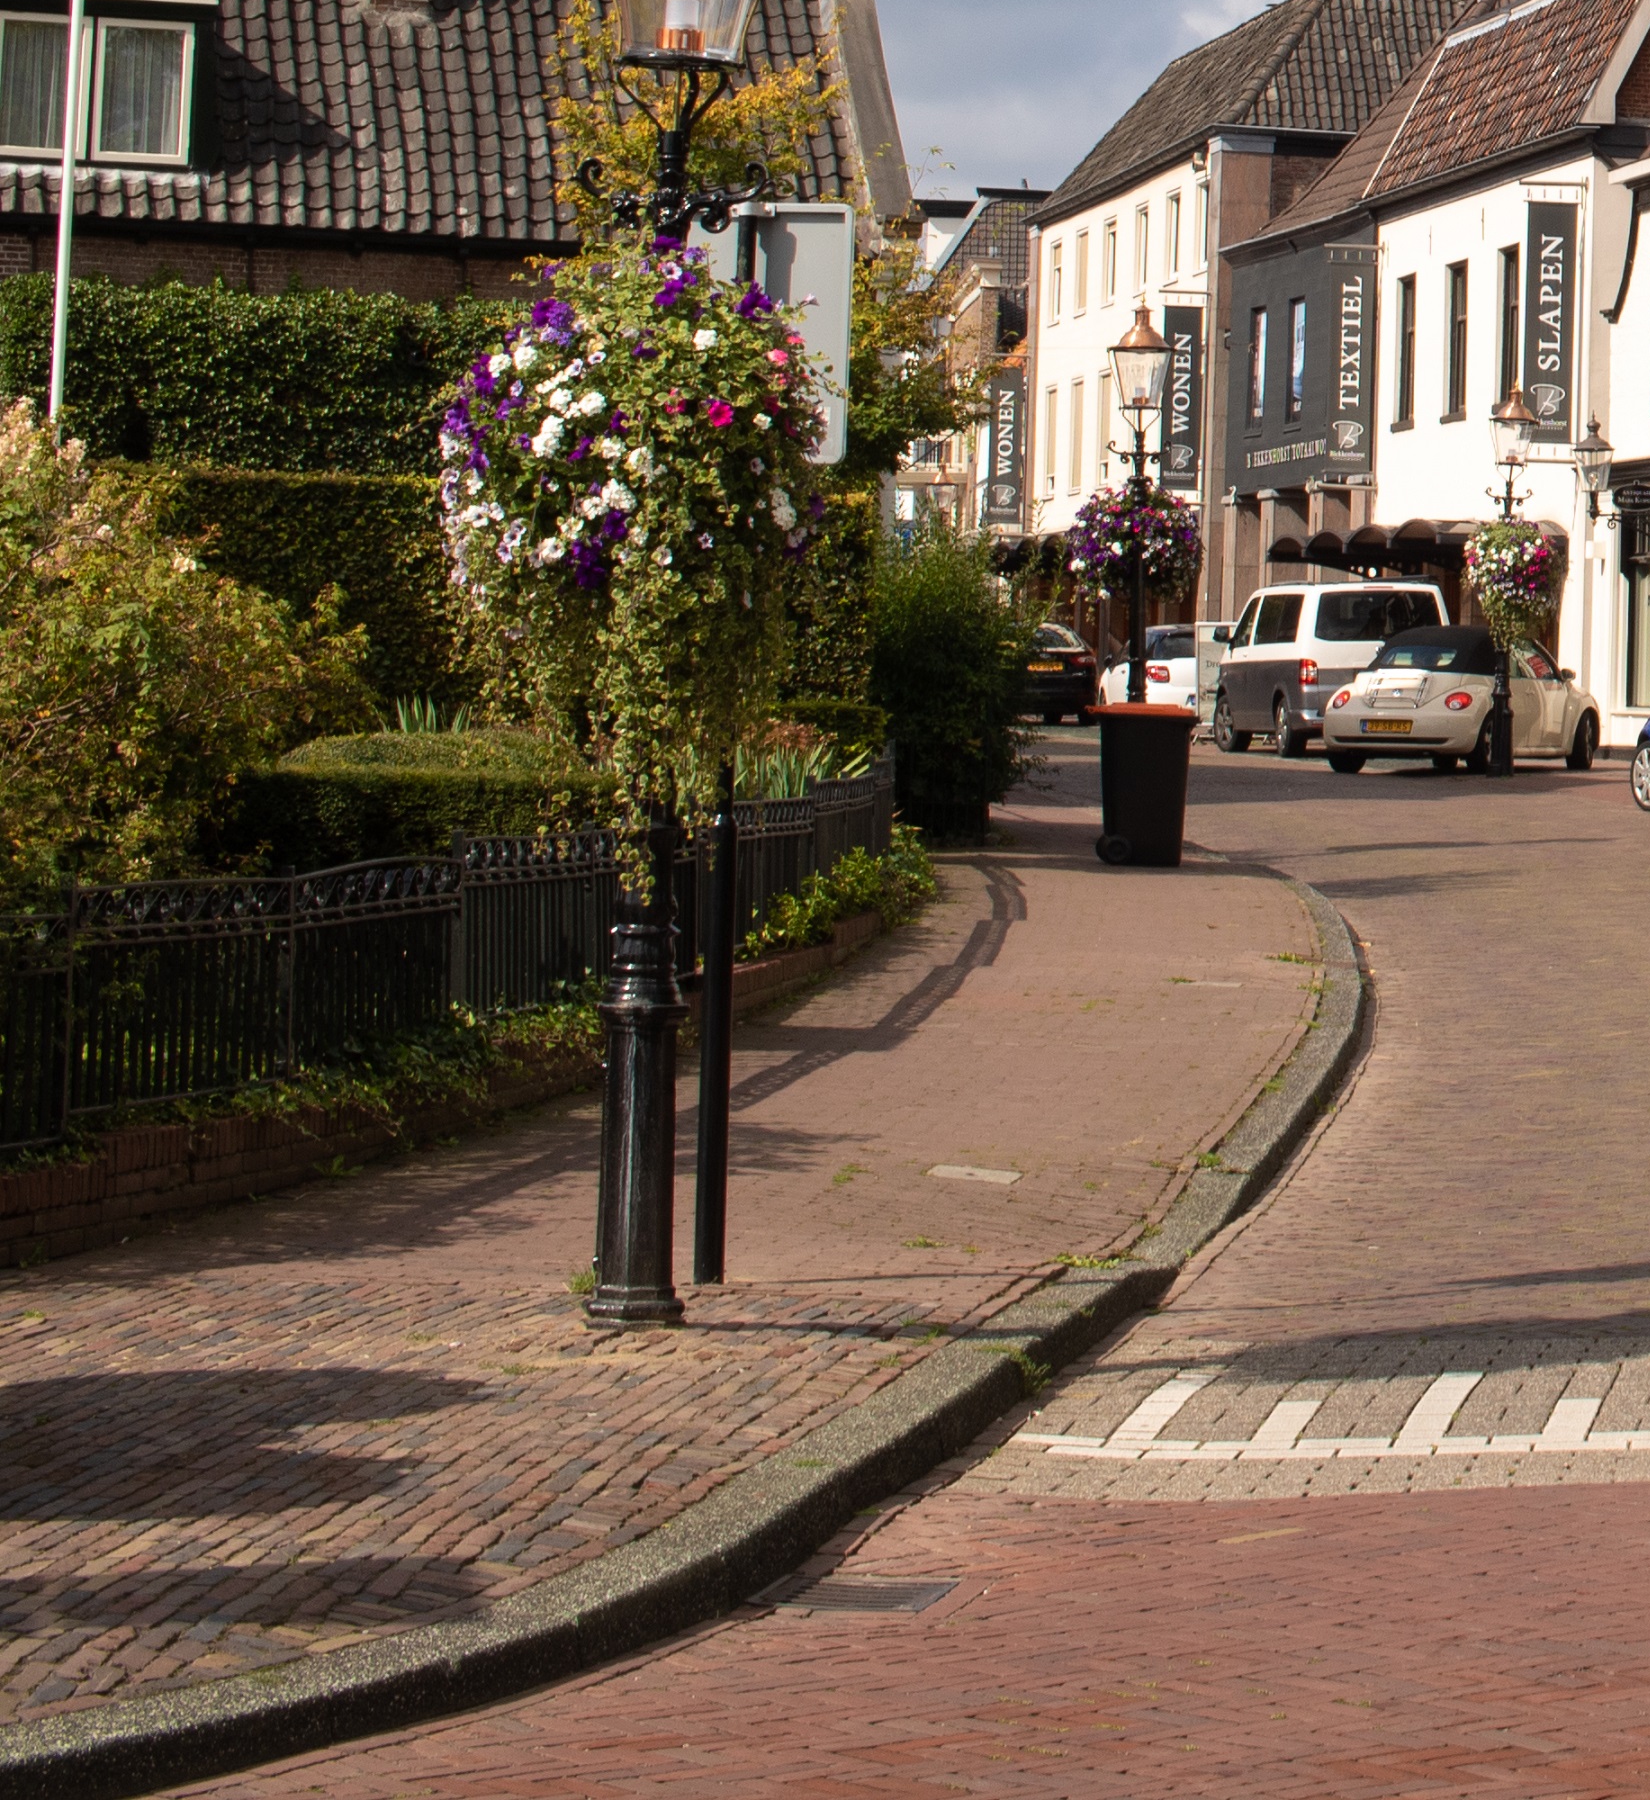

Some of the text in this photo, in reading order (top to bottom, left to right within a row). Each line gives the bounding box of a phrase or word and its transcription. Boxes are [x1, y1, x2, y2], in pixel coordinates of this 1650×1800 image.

[1338, 275, 1363, 410] TEXTIEL
[1537, 233, 1564, 372] SLAPEN
[996, 389, 1015, 478] WONEN
[1171, 332, 1193, 435] WONEN
[1246, 445, 1291, 469] BEKKENHORST
